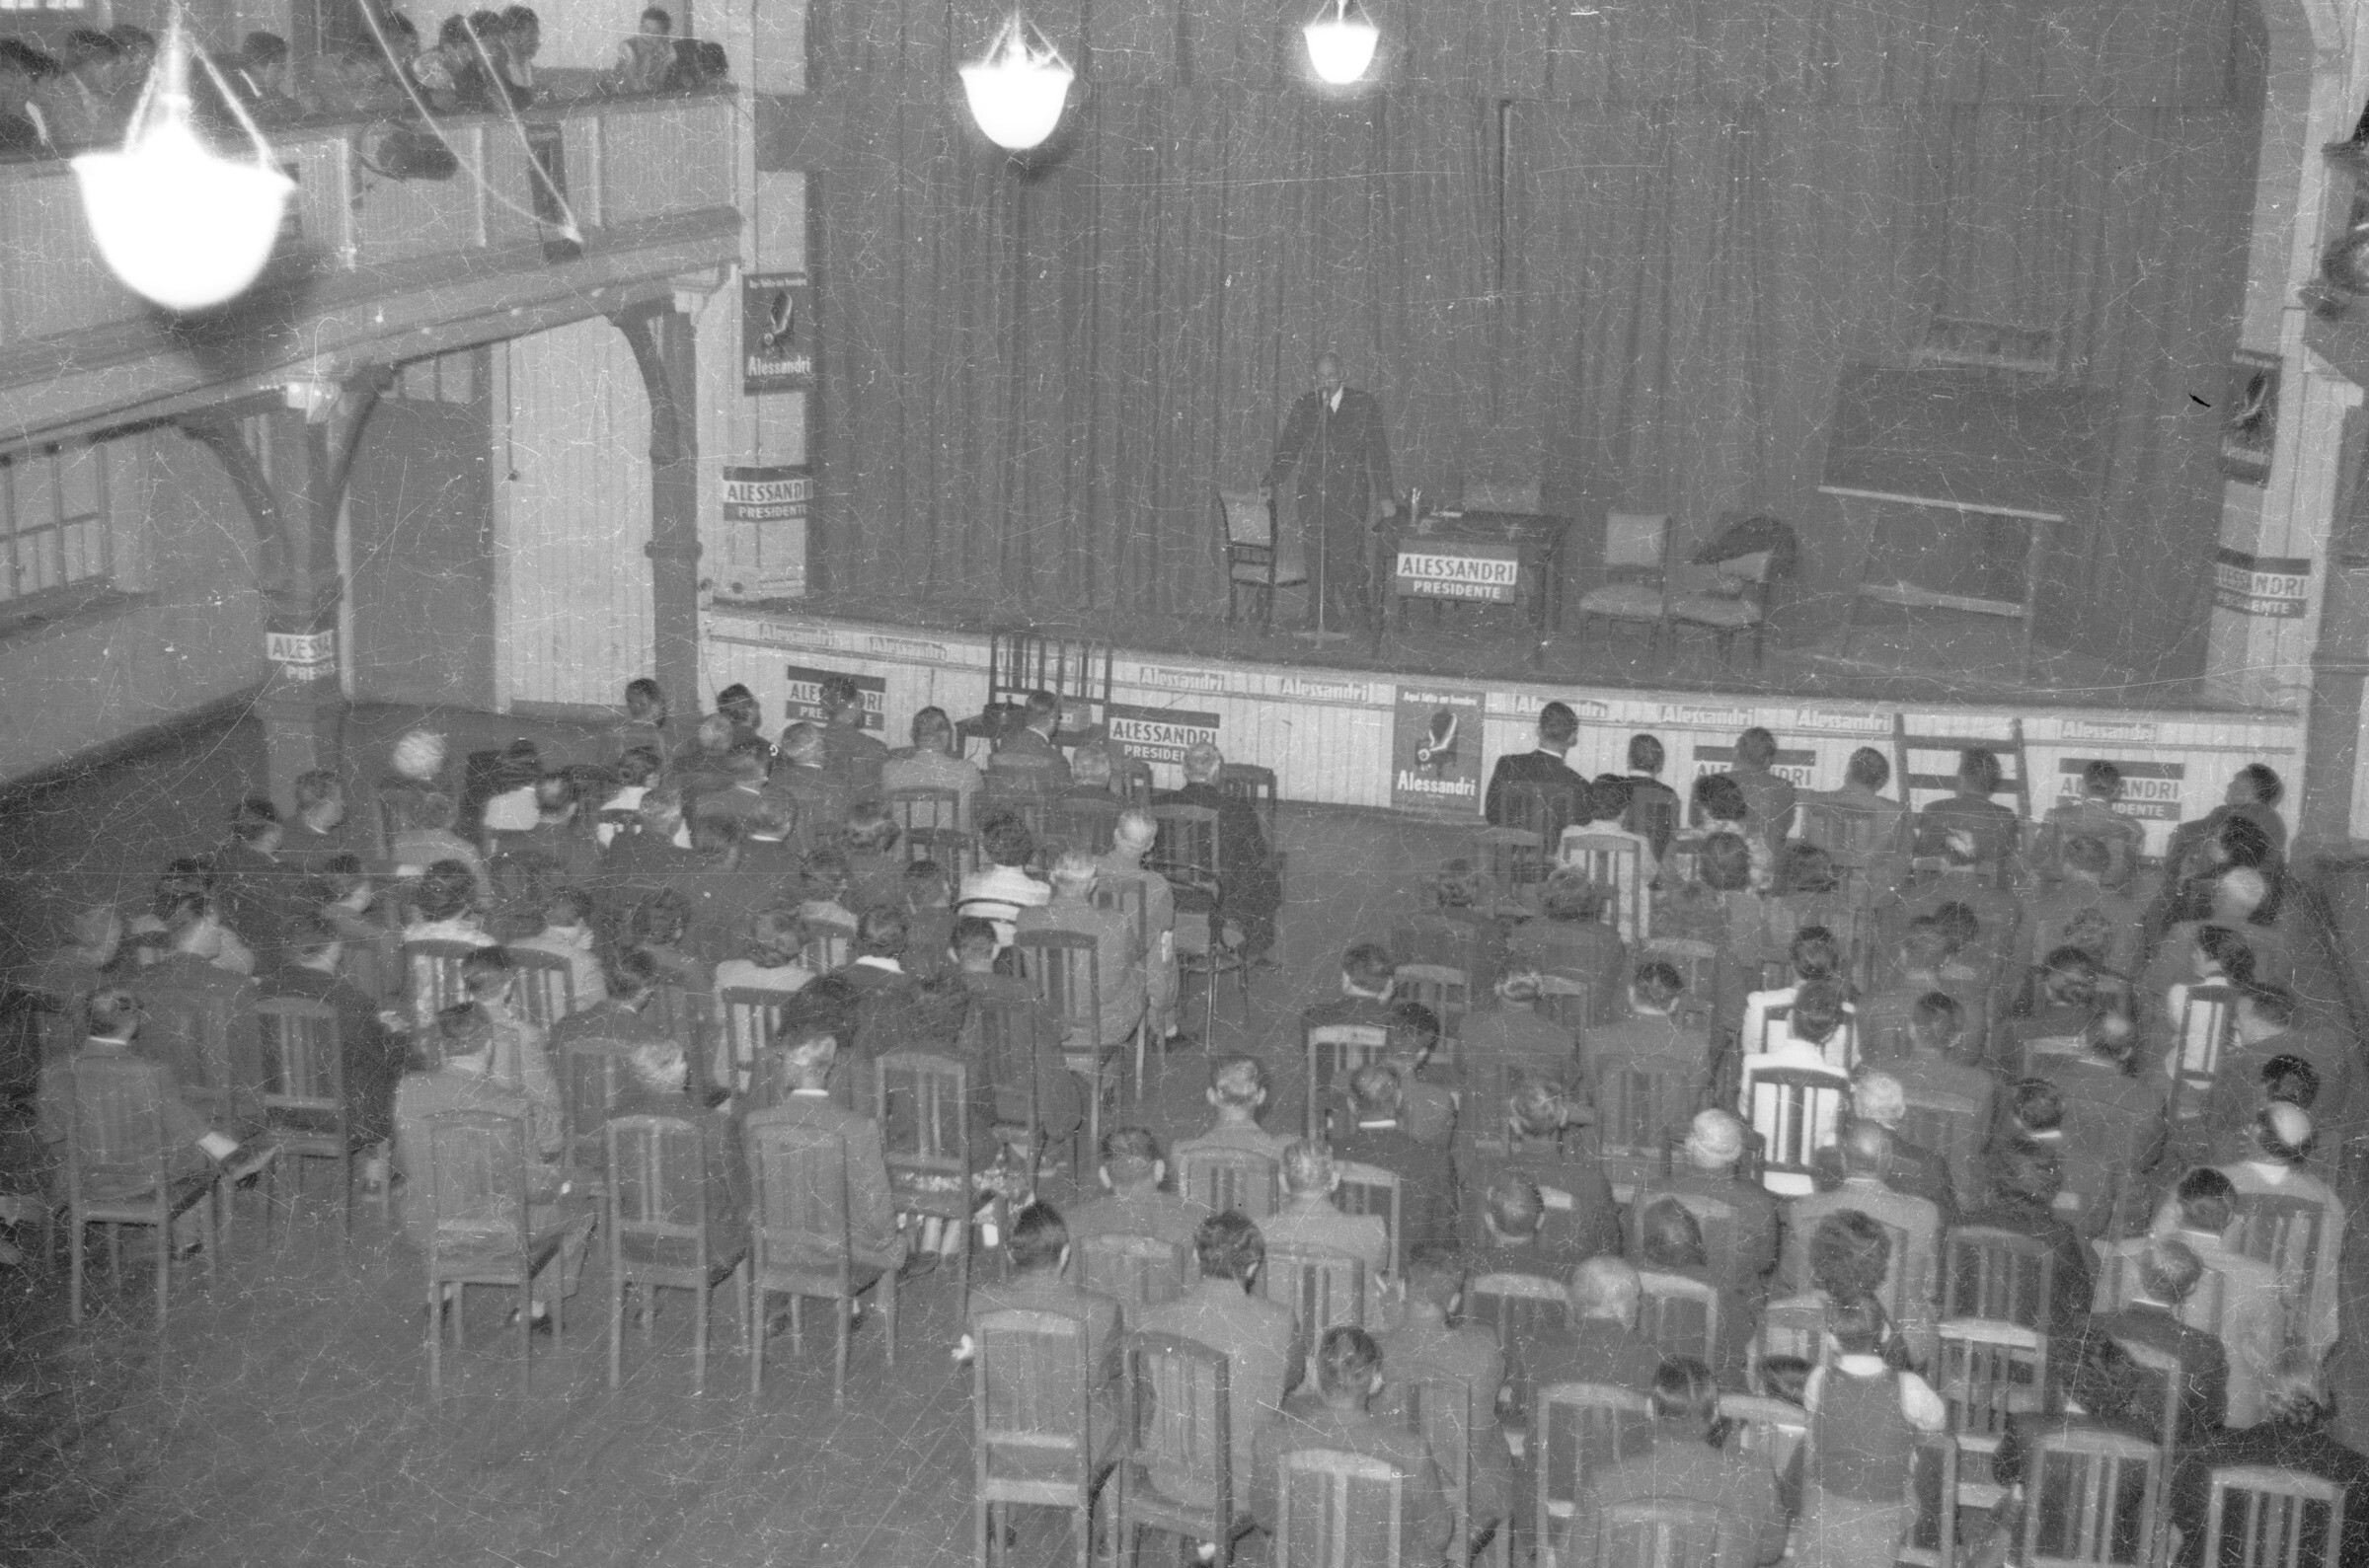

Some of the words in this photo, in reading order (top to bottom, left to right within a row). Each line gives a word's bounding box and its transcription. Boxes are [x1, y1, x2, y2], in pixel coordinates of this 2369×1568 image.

[748, 355, 811, 376] Alessandri
[1401, 557, 1514, 582] ALESSANDRI
[1413, 579, 1501, 599] PRESIDENTE
[1140, 667, 1223, 690] Alessandri
[1281, 679, 1367, 702] Alessandri
[1662, 707, 1753, 726] Alessandri
[1797, 709, 1889, 731] Alessandri
[1398, 770, 1477, 795] Alessandri
